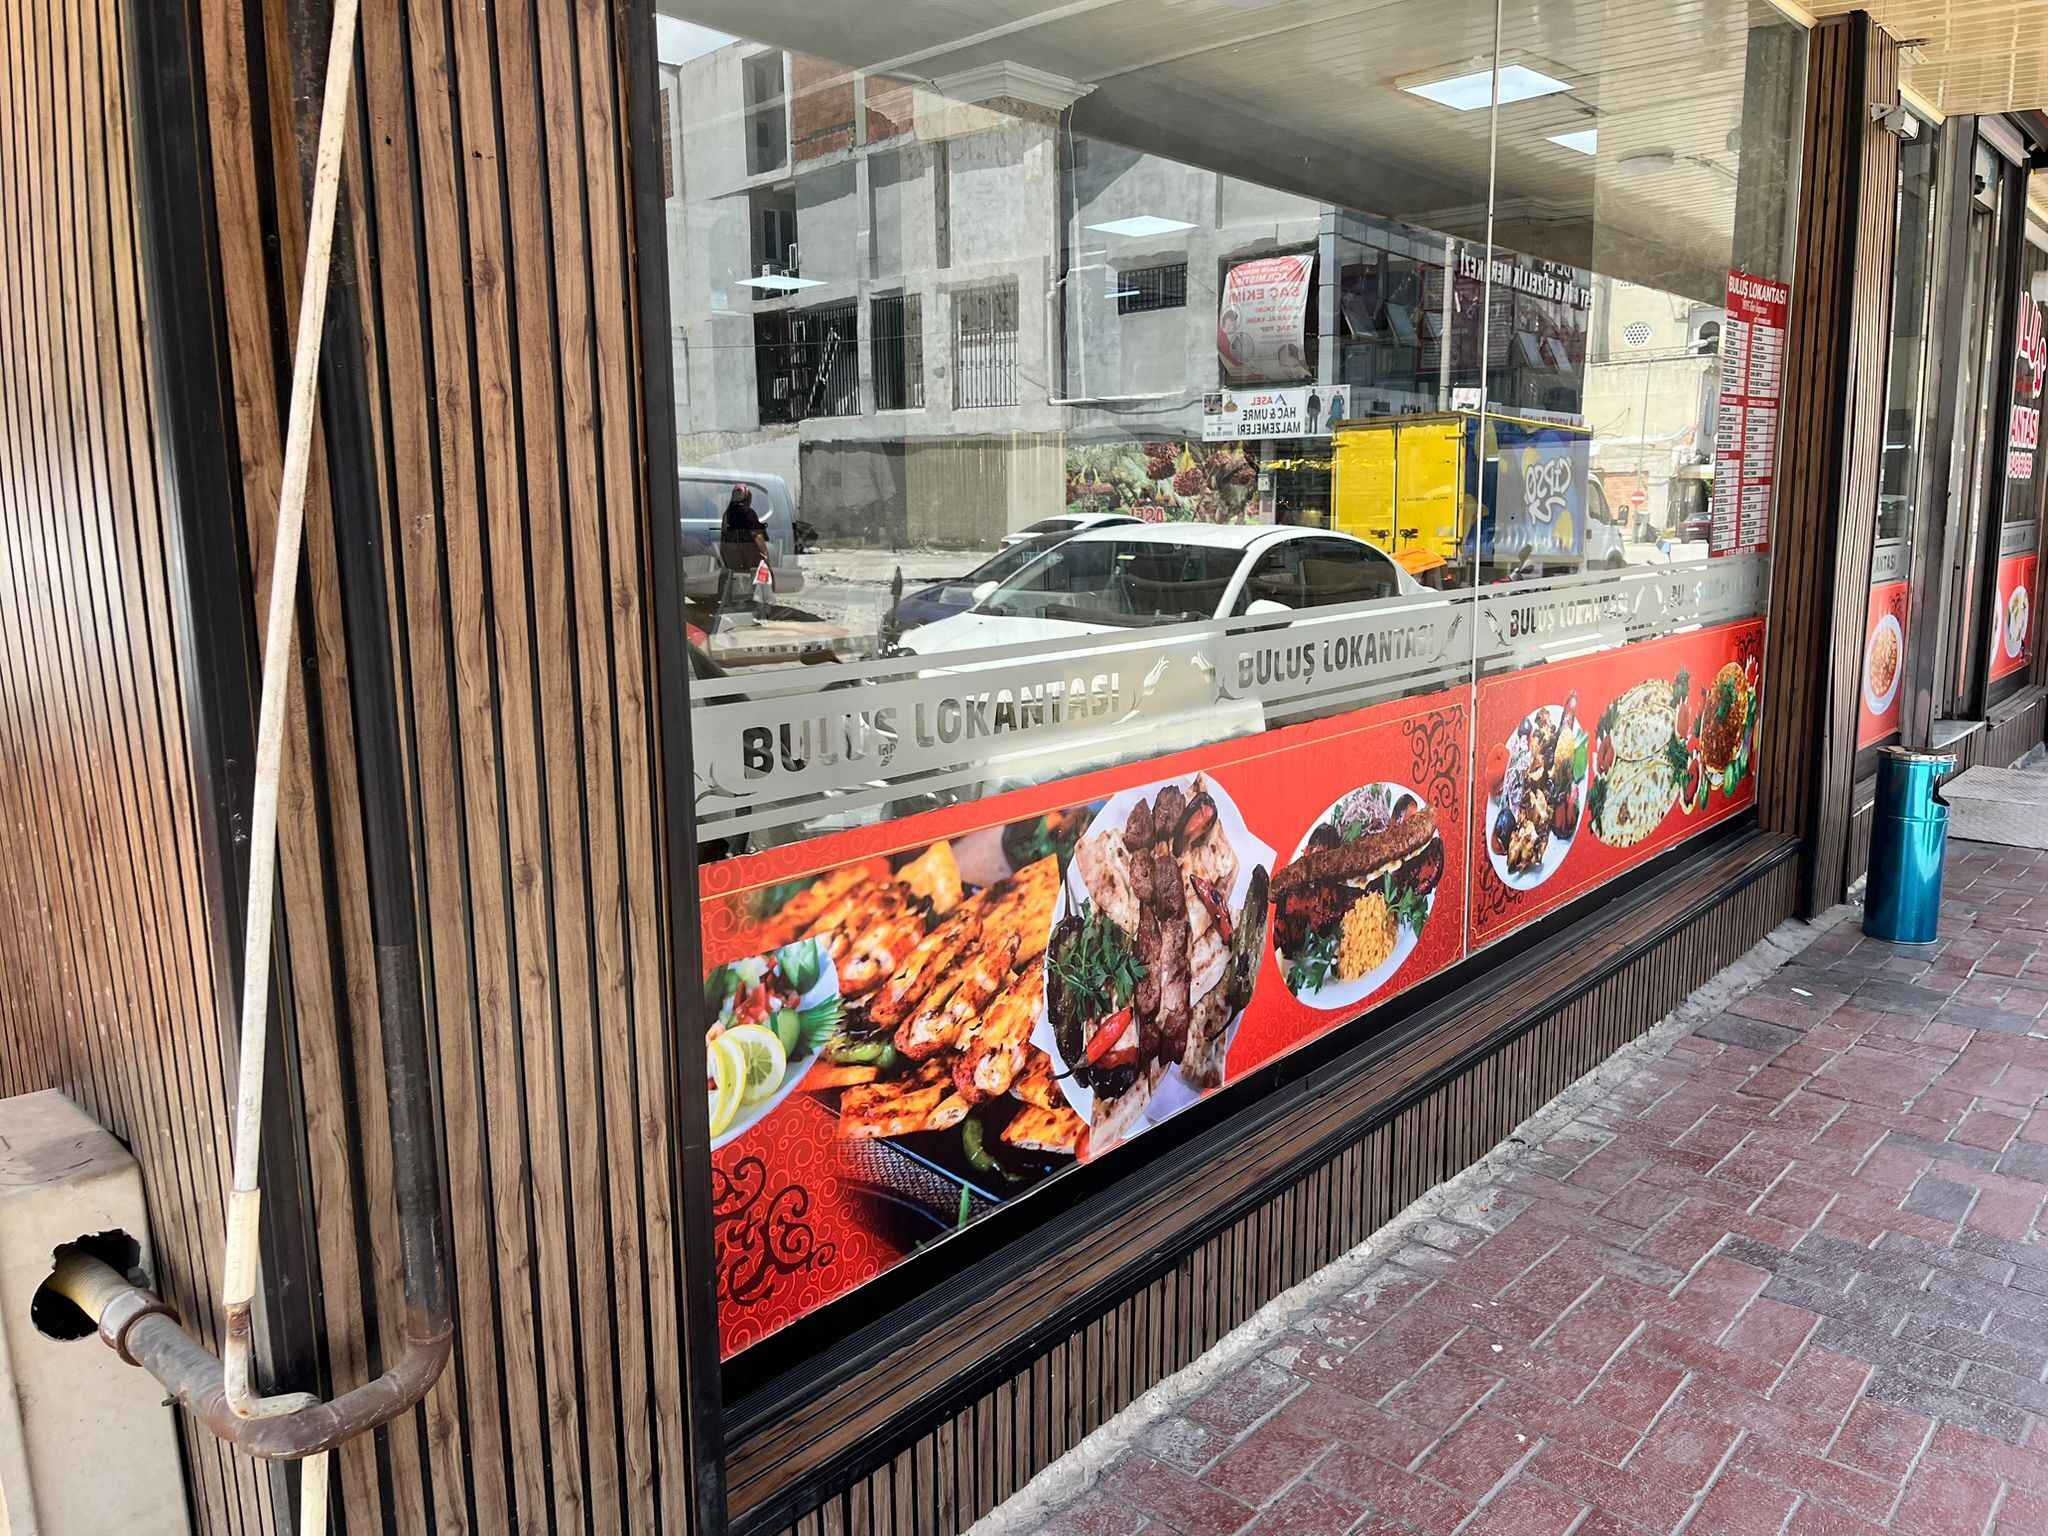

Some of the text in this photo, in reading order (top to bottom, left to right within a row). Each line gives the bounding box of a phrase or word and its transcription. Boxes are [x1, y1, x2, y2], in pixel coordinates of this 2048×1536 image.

[1728, 275, 1787, 306] BULUŞ LOKANTASI
[1510, 592, 1629, 638] BULUŞ LOKANTASI
[1238, 623, 1435, 689] BULUŞ LOKANTASI
[742, 672, 1120, 779] BULUŞ LOKANTASI
